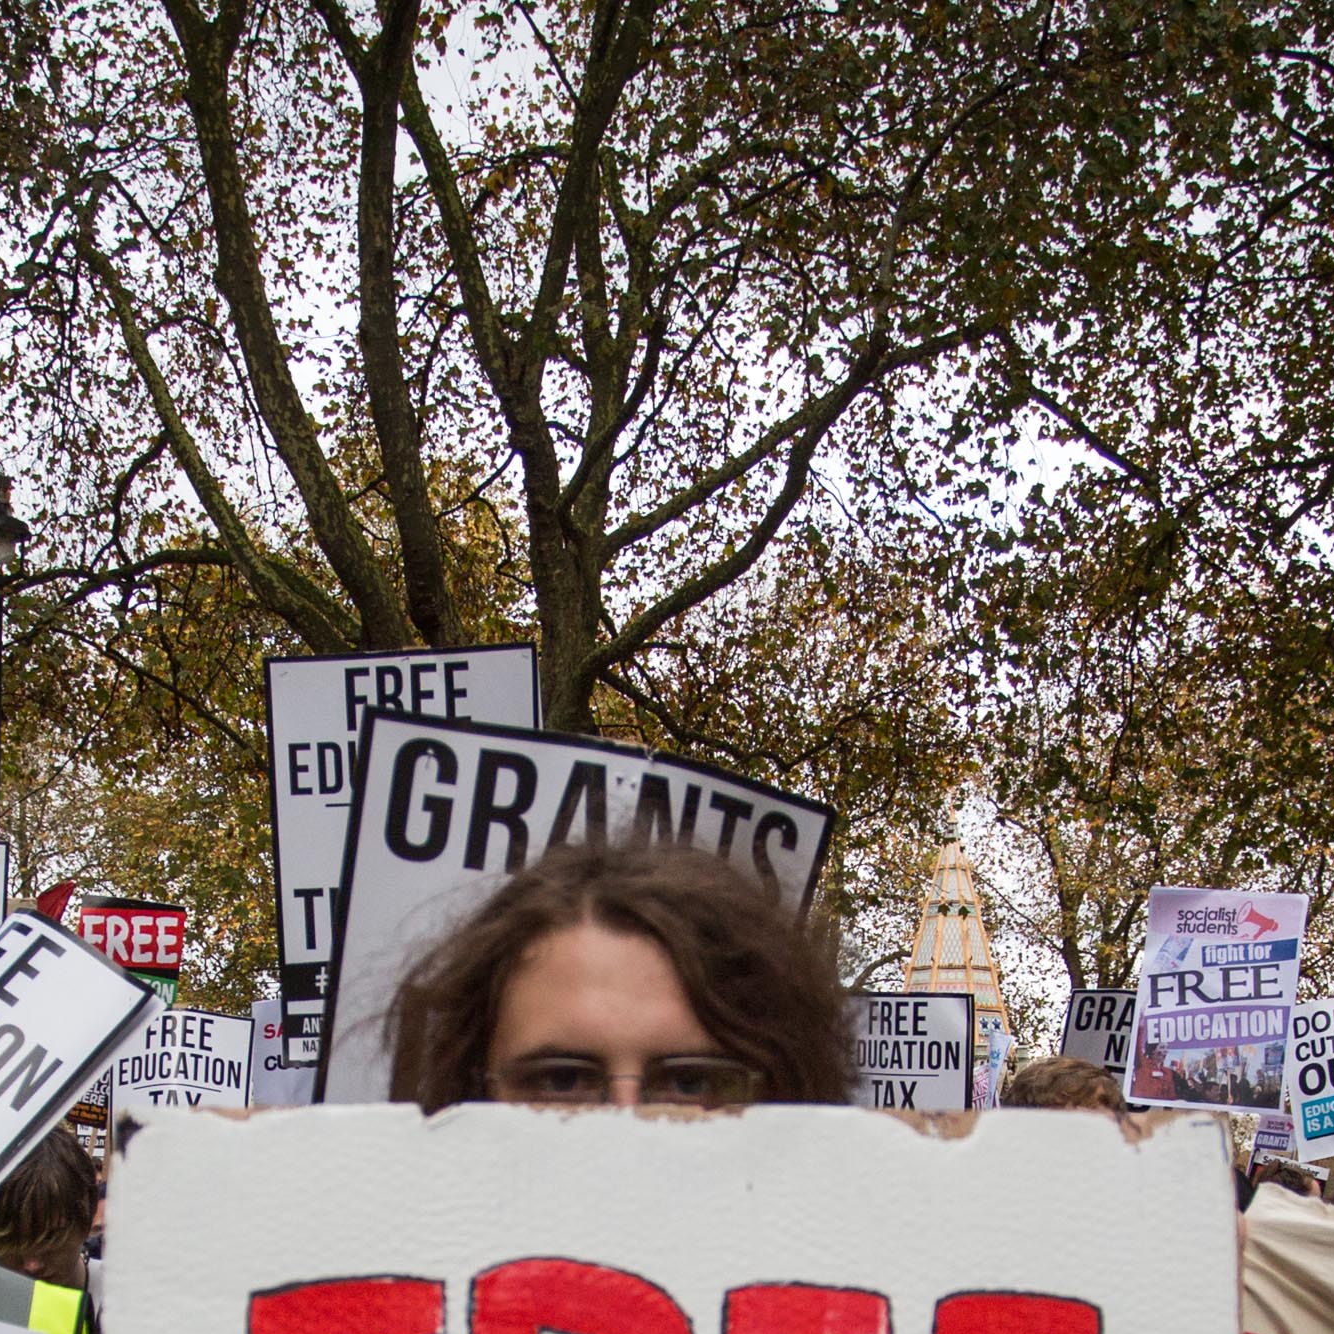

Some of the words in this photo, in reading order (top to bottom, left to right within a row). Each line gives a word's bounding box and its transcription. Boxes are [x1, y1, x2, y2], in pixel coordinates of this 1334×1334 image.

[344, 661, 471, 732] FREE
[1176, 916, 1238, 936] students
[1177, 907, 1237, 926] socialist
[82, 914, 179, 964] FREE
[1204, 945, 1245, 964] fight
[1247, 943, 1272, 960] for
[1147, 964, 1283, 1008] FREE
[868, 1001, 928, 1036] FREE
[1075, 996, 1136, 1032] GRA
[1146, 1009, 1283, 1044] EDUCATION
[119, 1052, 242, 1089] EDUCATION
[857, 1040, 960, 1070] DUCATION
[872, 1080, 917, 1110] TAX
[1307, 1119, 1320, 1132] IS
[1323, 1116, 1334, 1128] A
